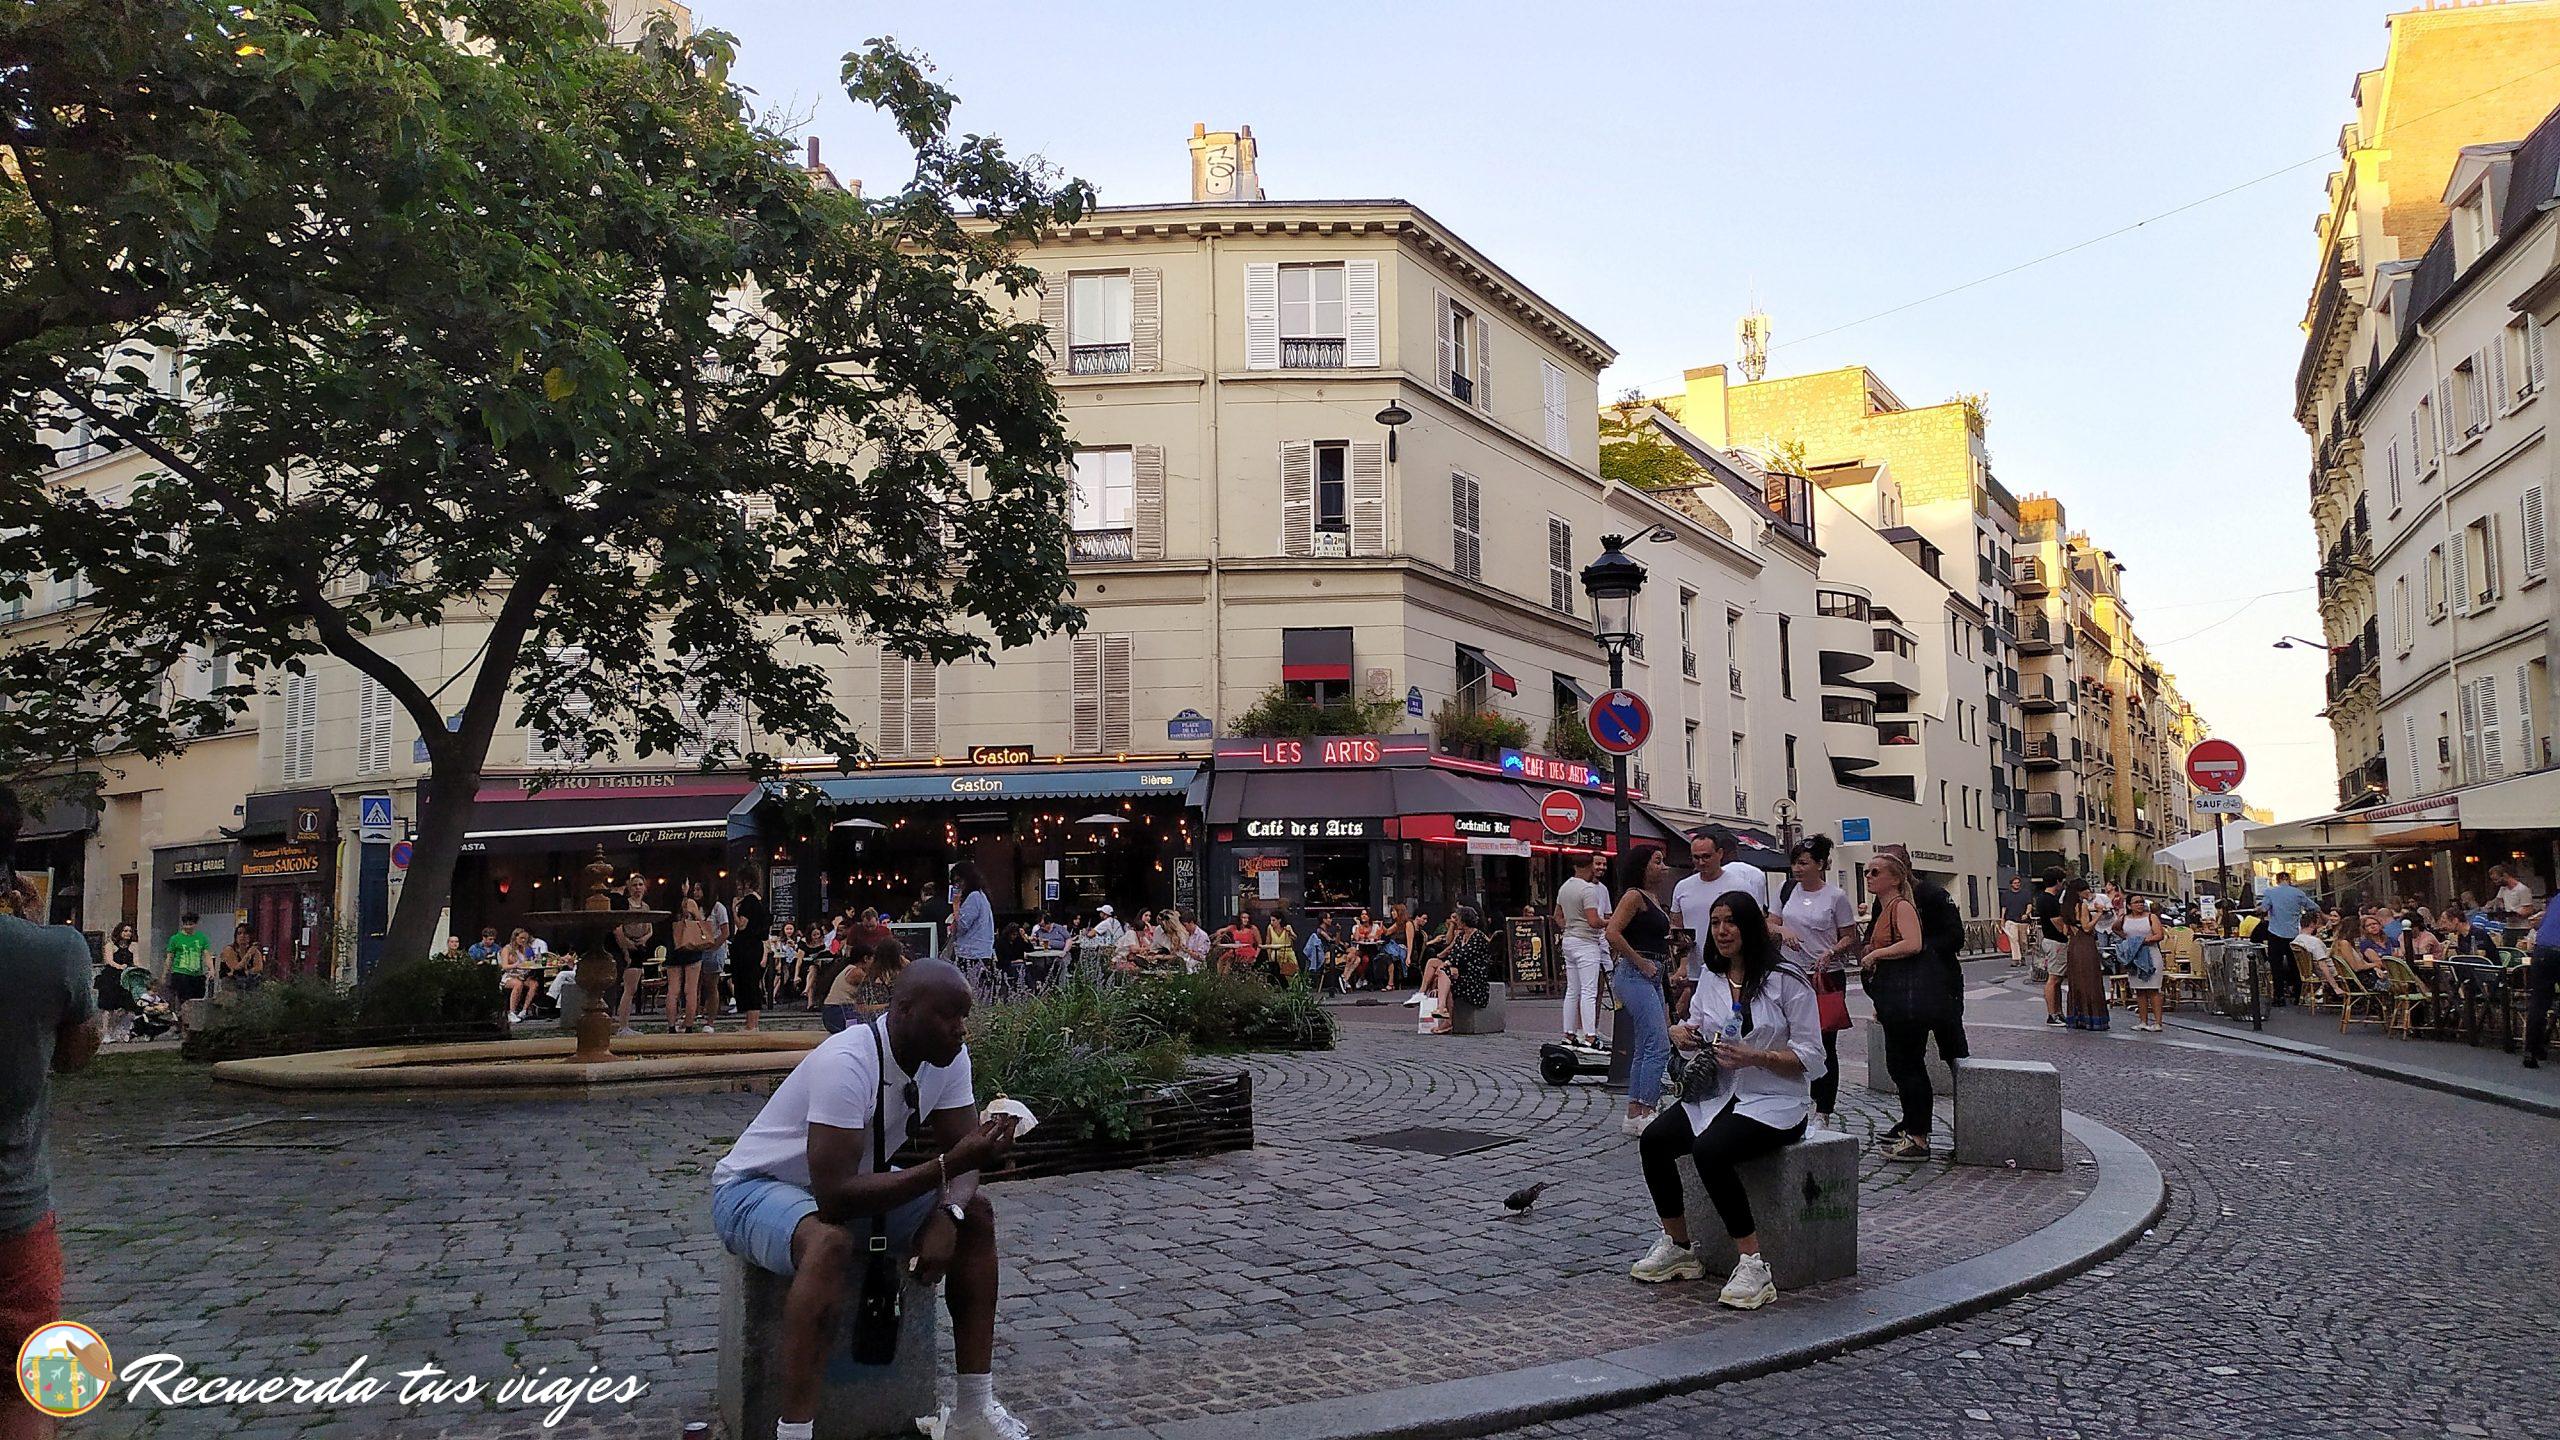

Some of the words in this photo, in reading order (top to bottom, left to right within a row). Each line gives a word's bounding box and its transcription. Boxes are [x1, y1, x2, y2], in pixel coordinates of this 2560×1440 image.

[973, 746, 1029, 764] Gaston
[1263, 742, 1301, 763] LES
[1324, 741, 1377, 763] ARTS
[1140, 775, 1173, 785] Bières
[1549, 761, 1565, 780] DES
[1567, 764, 1589, 785] ARTS
[518, 777, 590, 790] BTRO
[598, 775, 676, 788] ITALIEN
[951, 777, 1003, 793] Gaston
[2196, 800, 2222, 808] SAUF
[1246, 819, 1284, 837] Café
[1290, 821, 1319, 836] des
[1325, 819, 1364, 837] Arts
[1455, 819, 1491, 832] Cocktails
[1494, 821, 1511, 834] Bar
[657, 829, 687, 842] Bières
[460, 843, 486, 851] ASTA
[202, 858, 226, 870] GARAGE
[275, 856, 319, 873] SAIGON'S
